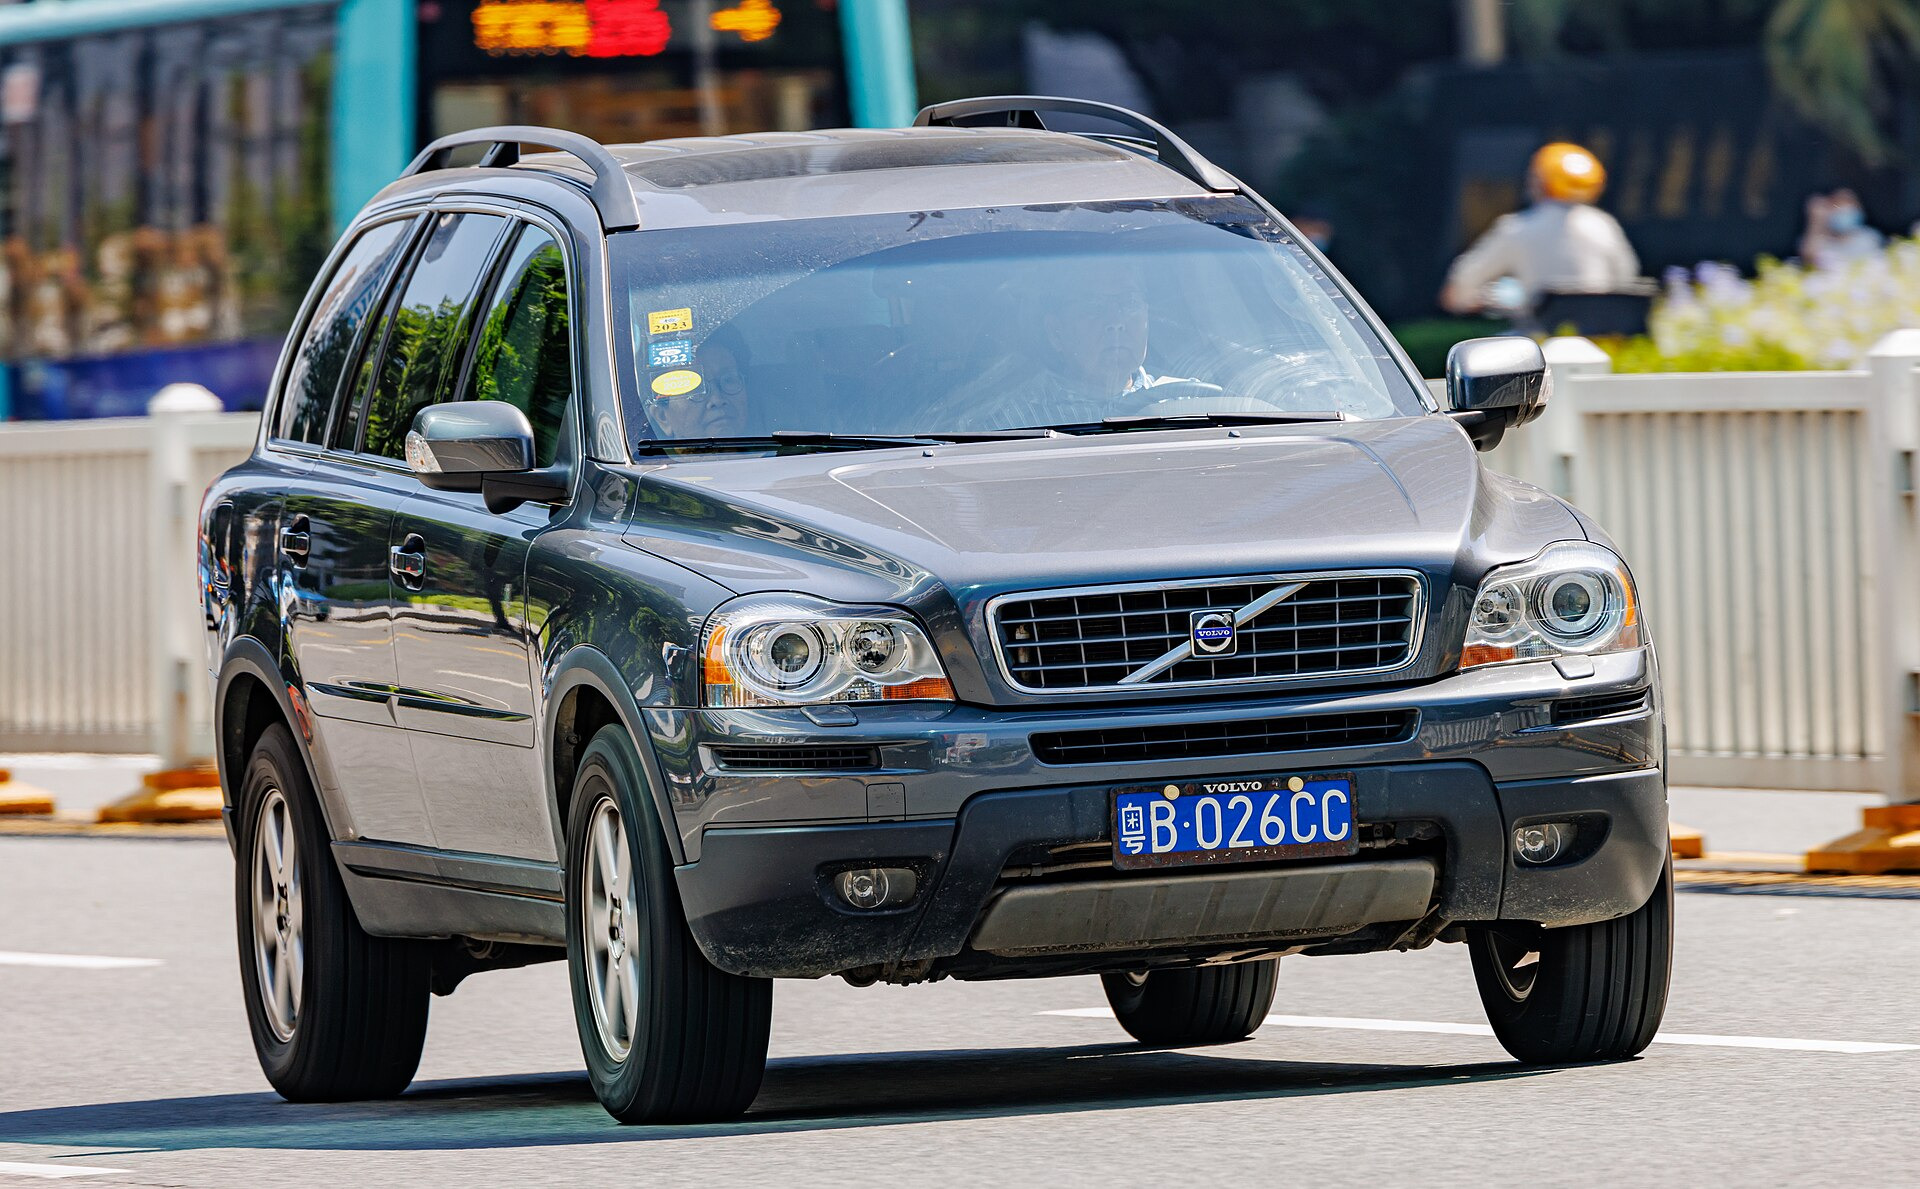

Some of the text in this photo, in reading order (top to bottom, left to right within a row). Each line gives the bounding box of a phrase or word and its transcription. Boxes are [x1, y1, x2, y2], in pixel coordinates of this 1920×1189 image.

[654, 321, 687, 332] 2023
[653, 353, 688, 365] 2022
[1198, 629, 1231, 637] VOLVO
[1203, 781, 1263, 793] VOLVO
